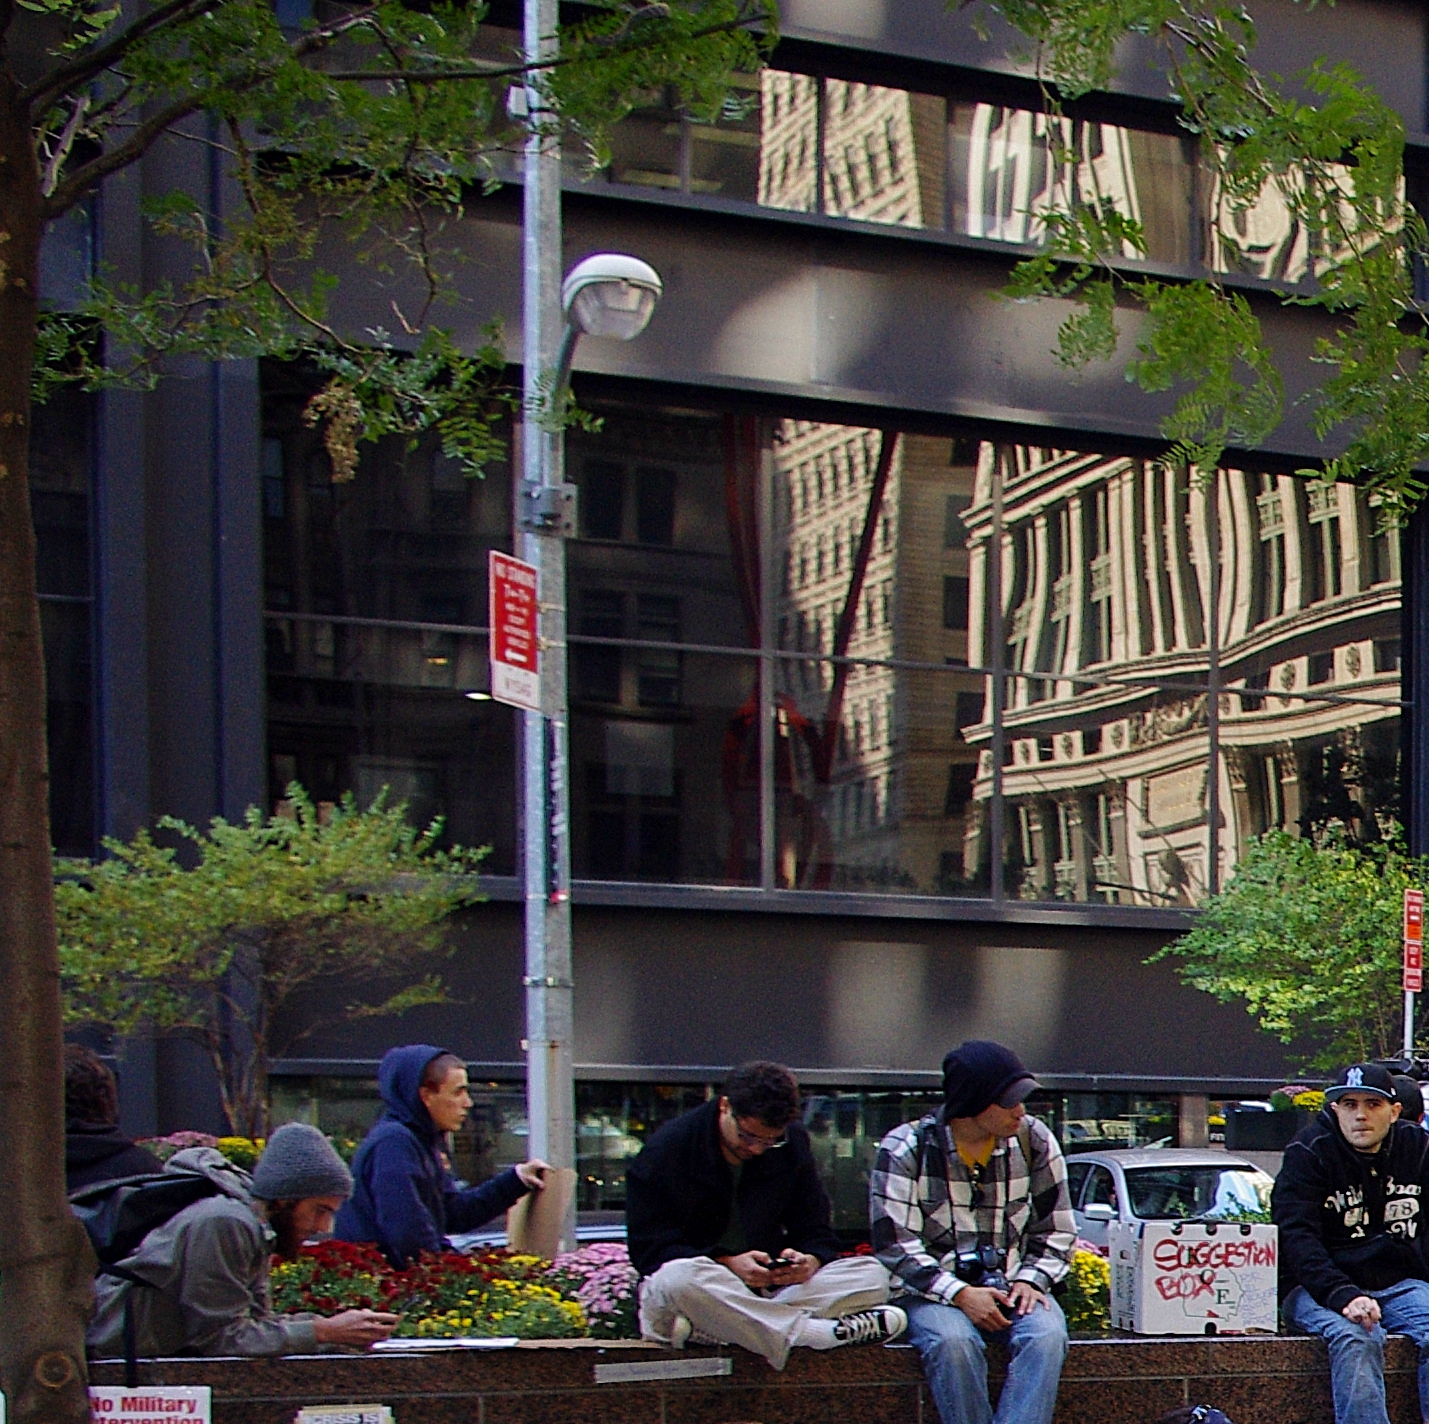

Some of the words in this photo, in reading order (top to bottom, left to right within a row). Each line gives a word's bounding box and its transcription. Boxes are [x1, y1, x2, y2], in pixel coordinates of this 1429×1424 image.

[1389, 1201, 1413, 1218] 78
[1153, 1238, 1277, 1272] SUGGESTION
[1154, 1270, 1216, 1301] BOX
[121, 1396, 197, 1414] Military
